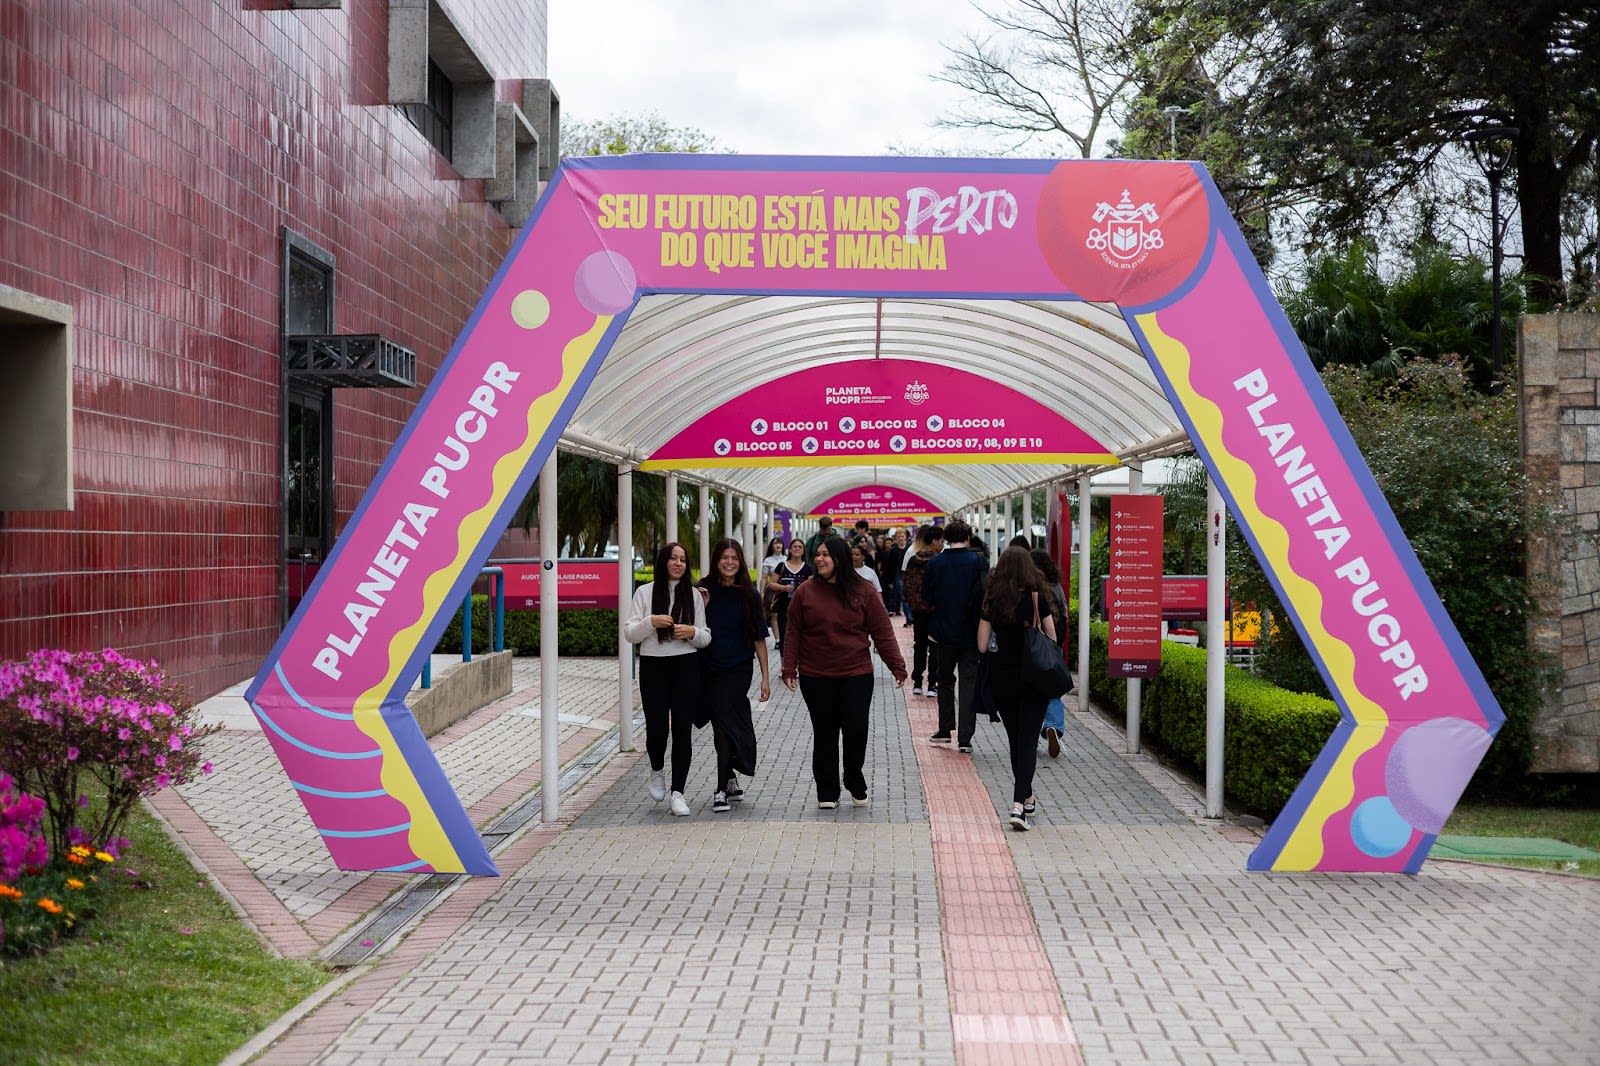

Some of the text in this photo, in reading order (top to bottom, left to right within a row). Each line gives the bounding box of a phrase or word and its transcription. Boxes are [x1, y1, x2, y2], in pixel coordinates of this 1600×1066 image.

[598, 185, 1018, 244] SEU FUTURO ESTÁ MAIS PERTO
[660, 228, 947, 274] DO QUE VOCÊ IMAGINA
[825, 386, 872, 396] PLANETA
[825, 396, 860, 405] PUCPR
[773, 421, 829, 432] BLOCO 01
[860, 419, 917, 430] BLOCO 03
[948, 418, 1005, 428] BLOCO 04
[735, 441, 792, 451] BLOCO 05
[823, 439, 880, 450] BLOCO 06
[911, 437, 1042, 450] BLOCOS 07, 08, 09 E 10
[311, 360, 520, 681] PLANETA PUCPR
[1233, 367, 1429, 701] PLANETA PUCPR
